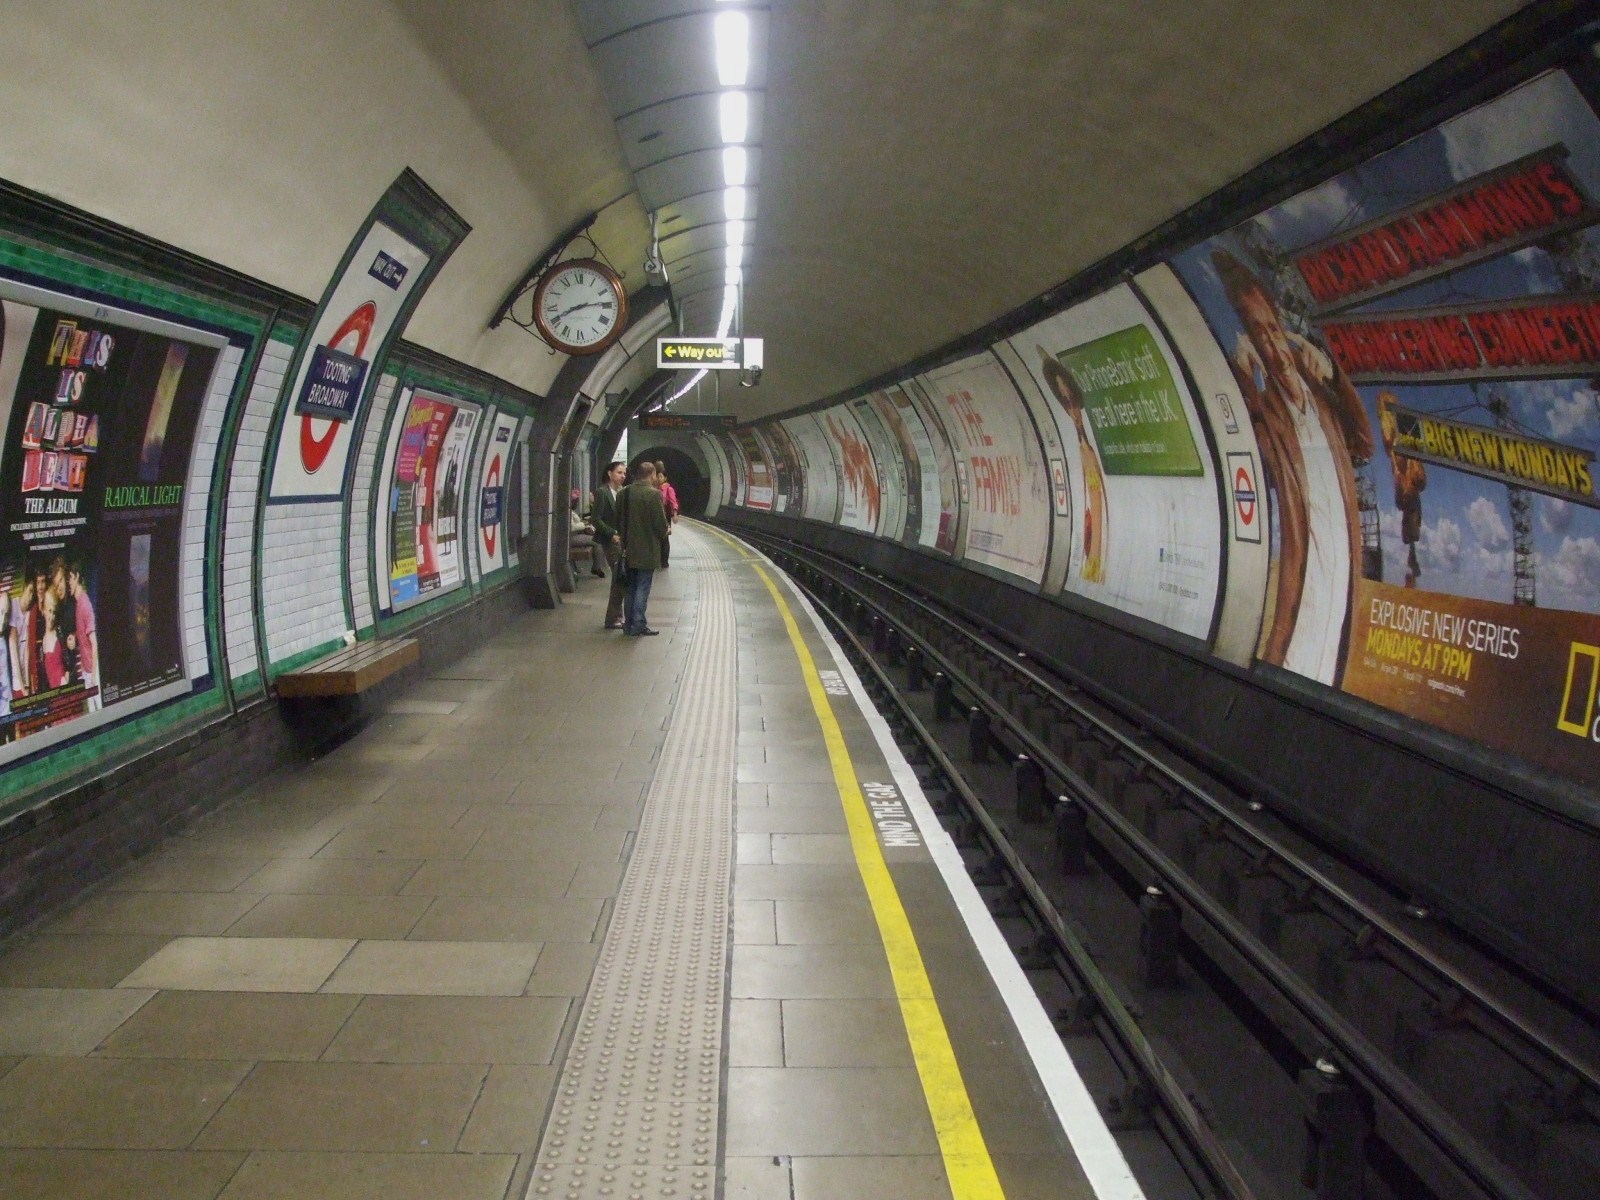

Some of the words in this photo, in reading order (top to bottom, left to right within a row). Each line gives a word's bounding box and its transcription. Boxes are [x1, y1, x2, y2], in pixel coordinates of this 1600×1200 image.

[677, 345, 705, 360] Way
[705, 346, 728, 358] out
[1135, 344, 1161, 381] staff
[322, 359, 352, 384] TOOTING
[56, 368, 86, 402] IS
[307, 383, 350, 409] BROADWAY
[1110, 396, 1138, 426] here
[1421, 418, 1456, 459] BIG
[1454, 427, 1501, 470] NEW
[1501, 437, 1593, 497] MONDAYS
[25, 498, 45, 514] THE
[45, 499, 78, 514] ALBUM
[104, 487, 150, 507] RADICAL
[152, 485, 182, 505] LIGHT
[1370, 598, 1432, 638] EXPLOSIVE
[1432, 611, 1466, 645] NEW
[1465, 619, 1520, 660] SERIES
[1366, 627, 1423, 666] MONDAYS
[1421, 643, 1442, 671] AT
[1441, 647, 1473, 681] 9PM
[863, 781, 898, 799] GAP
[870, 800, 906, 818] THE
[877, 820, 921, 847] MIND
